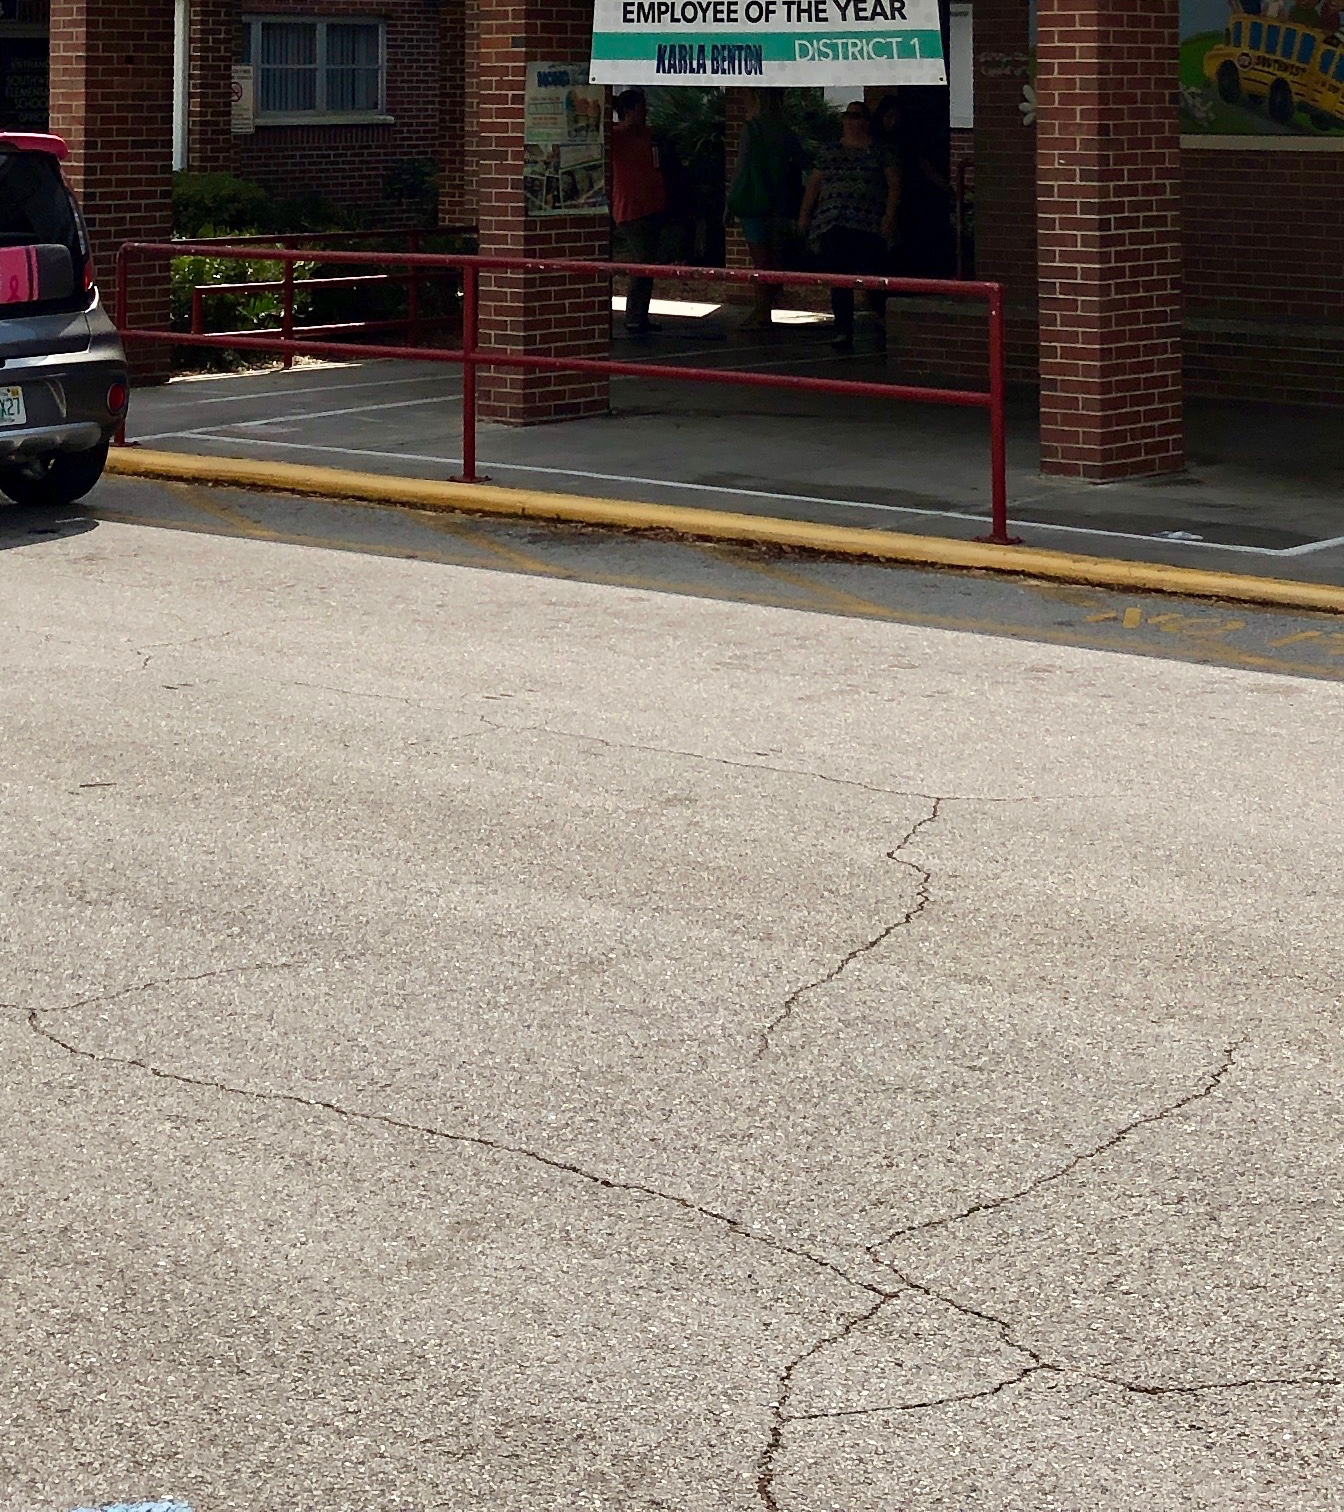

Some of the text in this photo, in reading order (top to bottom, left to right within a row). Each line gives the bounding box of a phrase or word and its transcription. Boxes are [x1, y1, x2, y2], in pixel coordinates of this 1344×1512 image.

[623, 0, 739, 23] EMPLOYEE
[745, 0, 777, 23] OF
[782, 0, 829, 22] THE
[656, 44, 763, 75] KARLA BENTON
[794, 37, 921, 61] DISTRICT 1
[1085, 606, 1247, 636] NO
